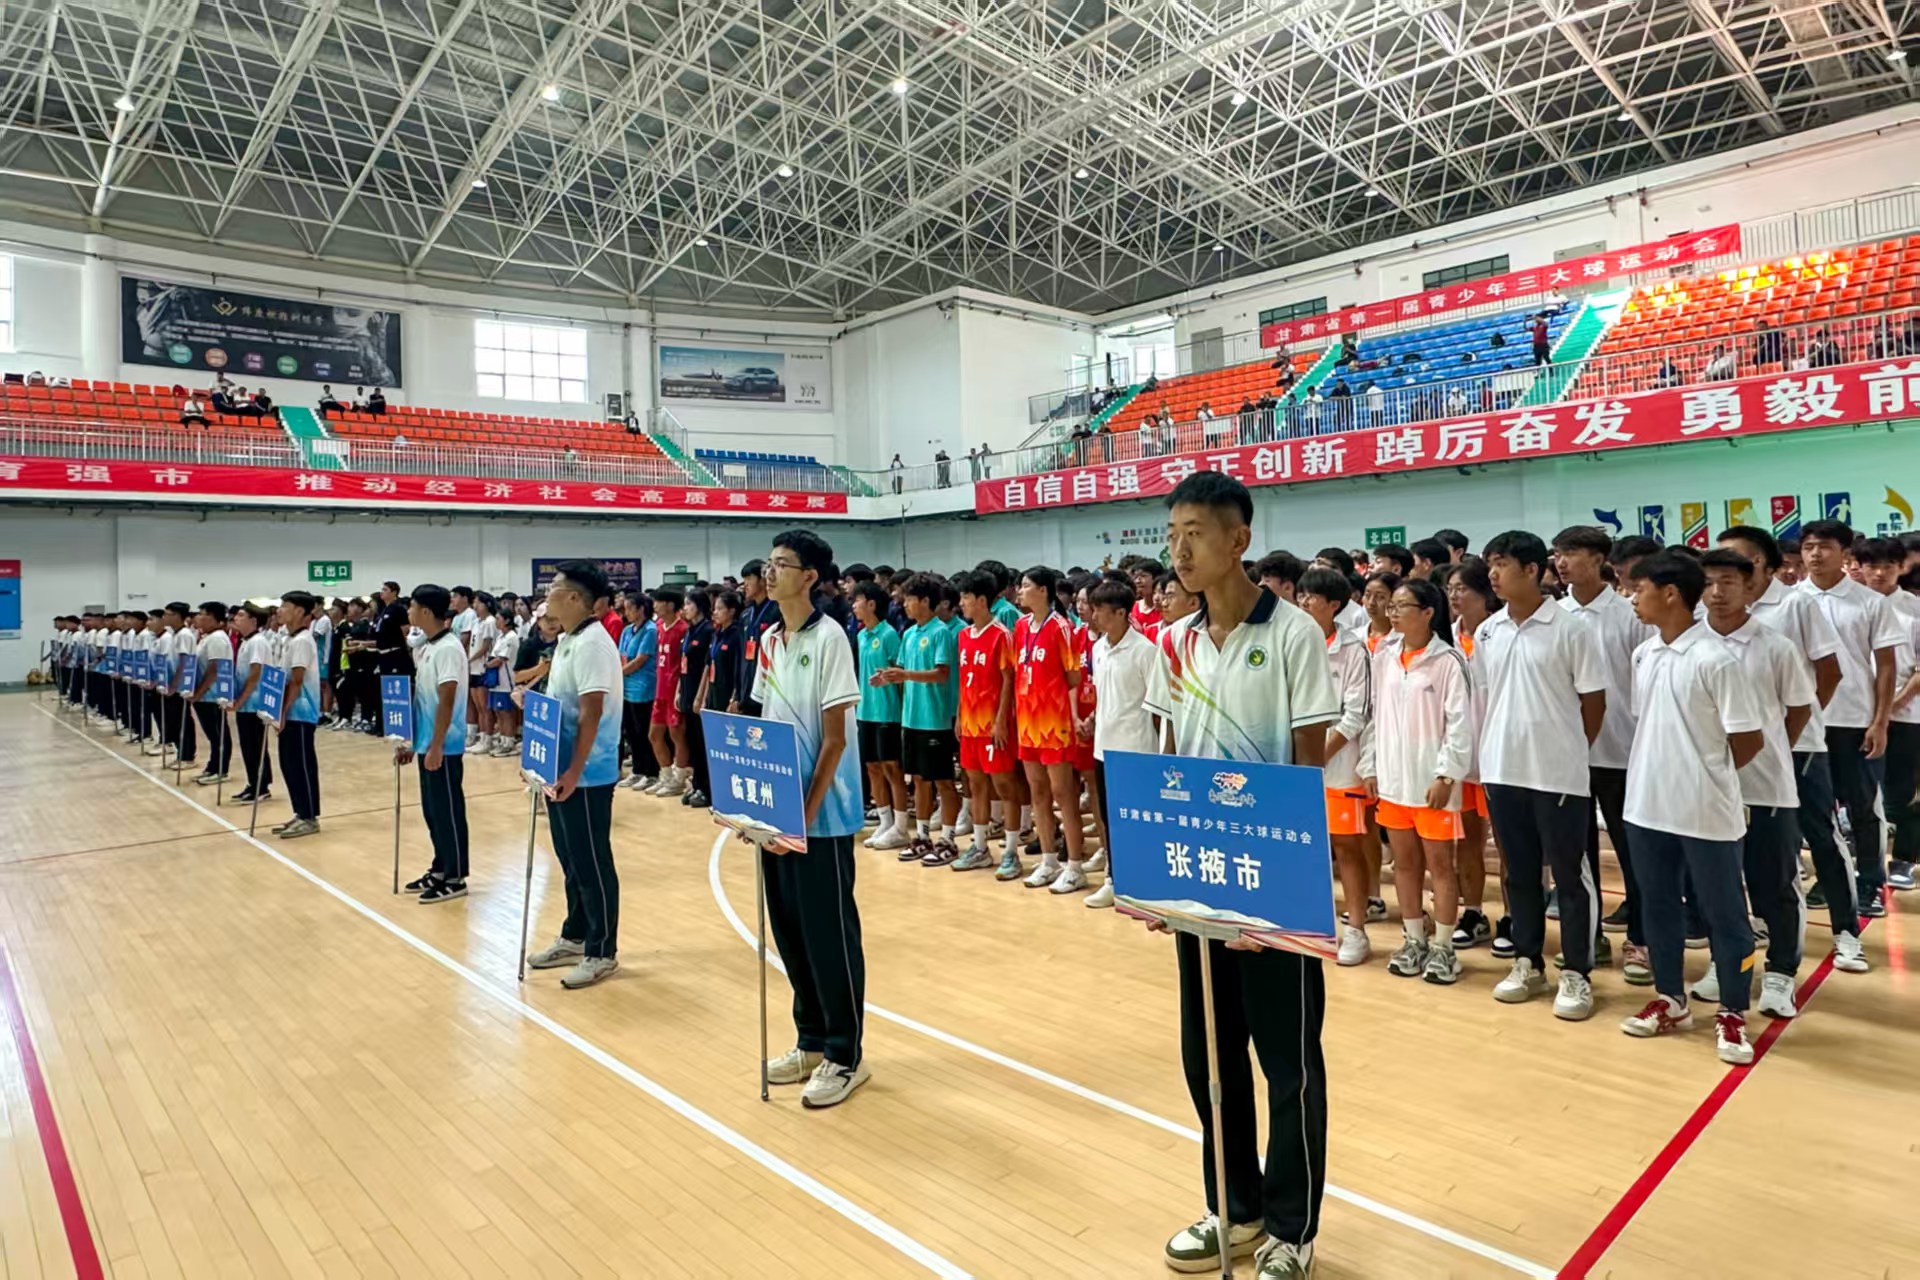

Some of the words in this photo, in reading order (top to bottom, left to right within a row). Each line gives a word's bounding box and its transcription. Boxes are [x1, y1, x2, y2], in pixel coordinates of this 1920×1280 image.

[1274, 237, 1718, 342] 甘肃省第一届青少年三大球运动会
[1004, 465, 1141, 509] 自信自强
[1375, 401, 1634, 466] 踔厉奋发
[294, 473, 827, 509] 推动经济社会高质量发展
[1370, 531, 1402, 545] 北出口
[312, 564, 348, 577] 西出口
[966, 672, 974, 688] 7
[985, 744, 994, 762] 7
[731, 773, 774, 809] 临夏州
[1119, 807, 1312, 845] 甘肃省第一届青少年三大球运动会
[1165, 842, 1262, 891] 张掖市
